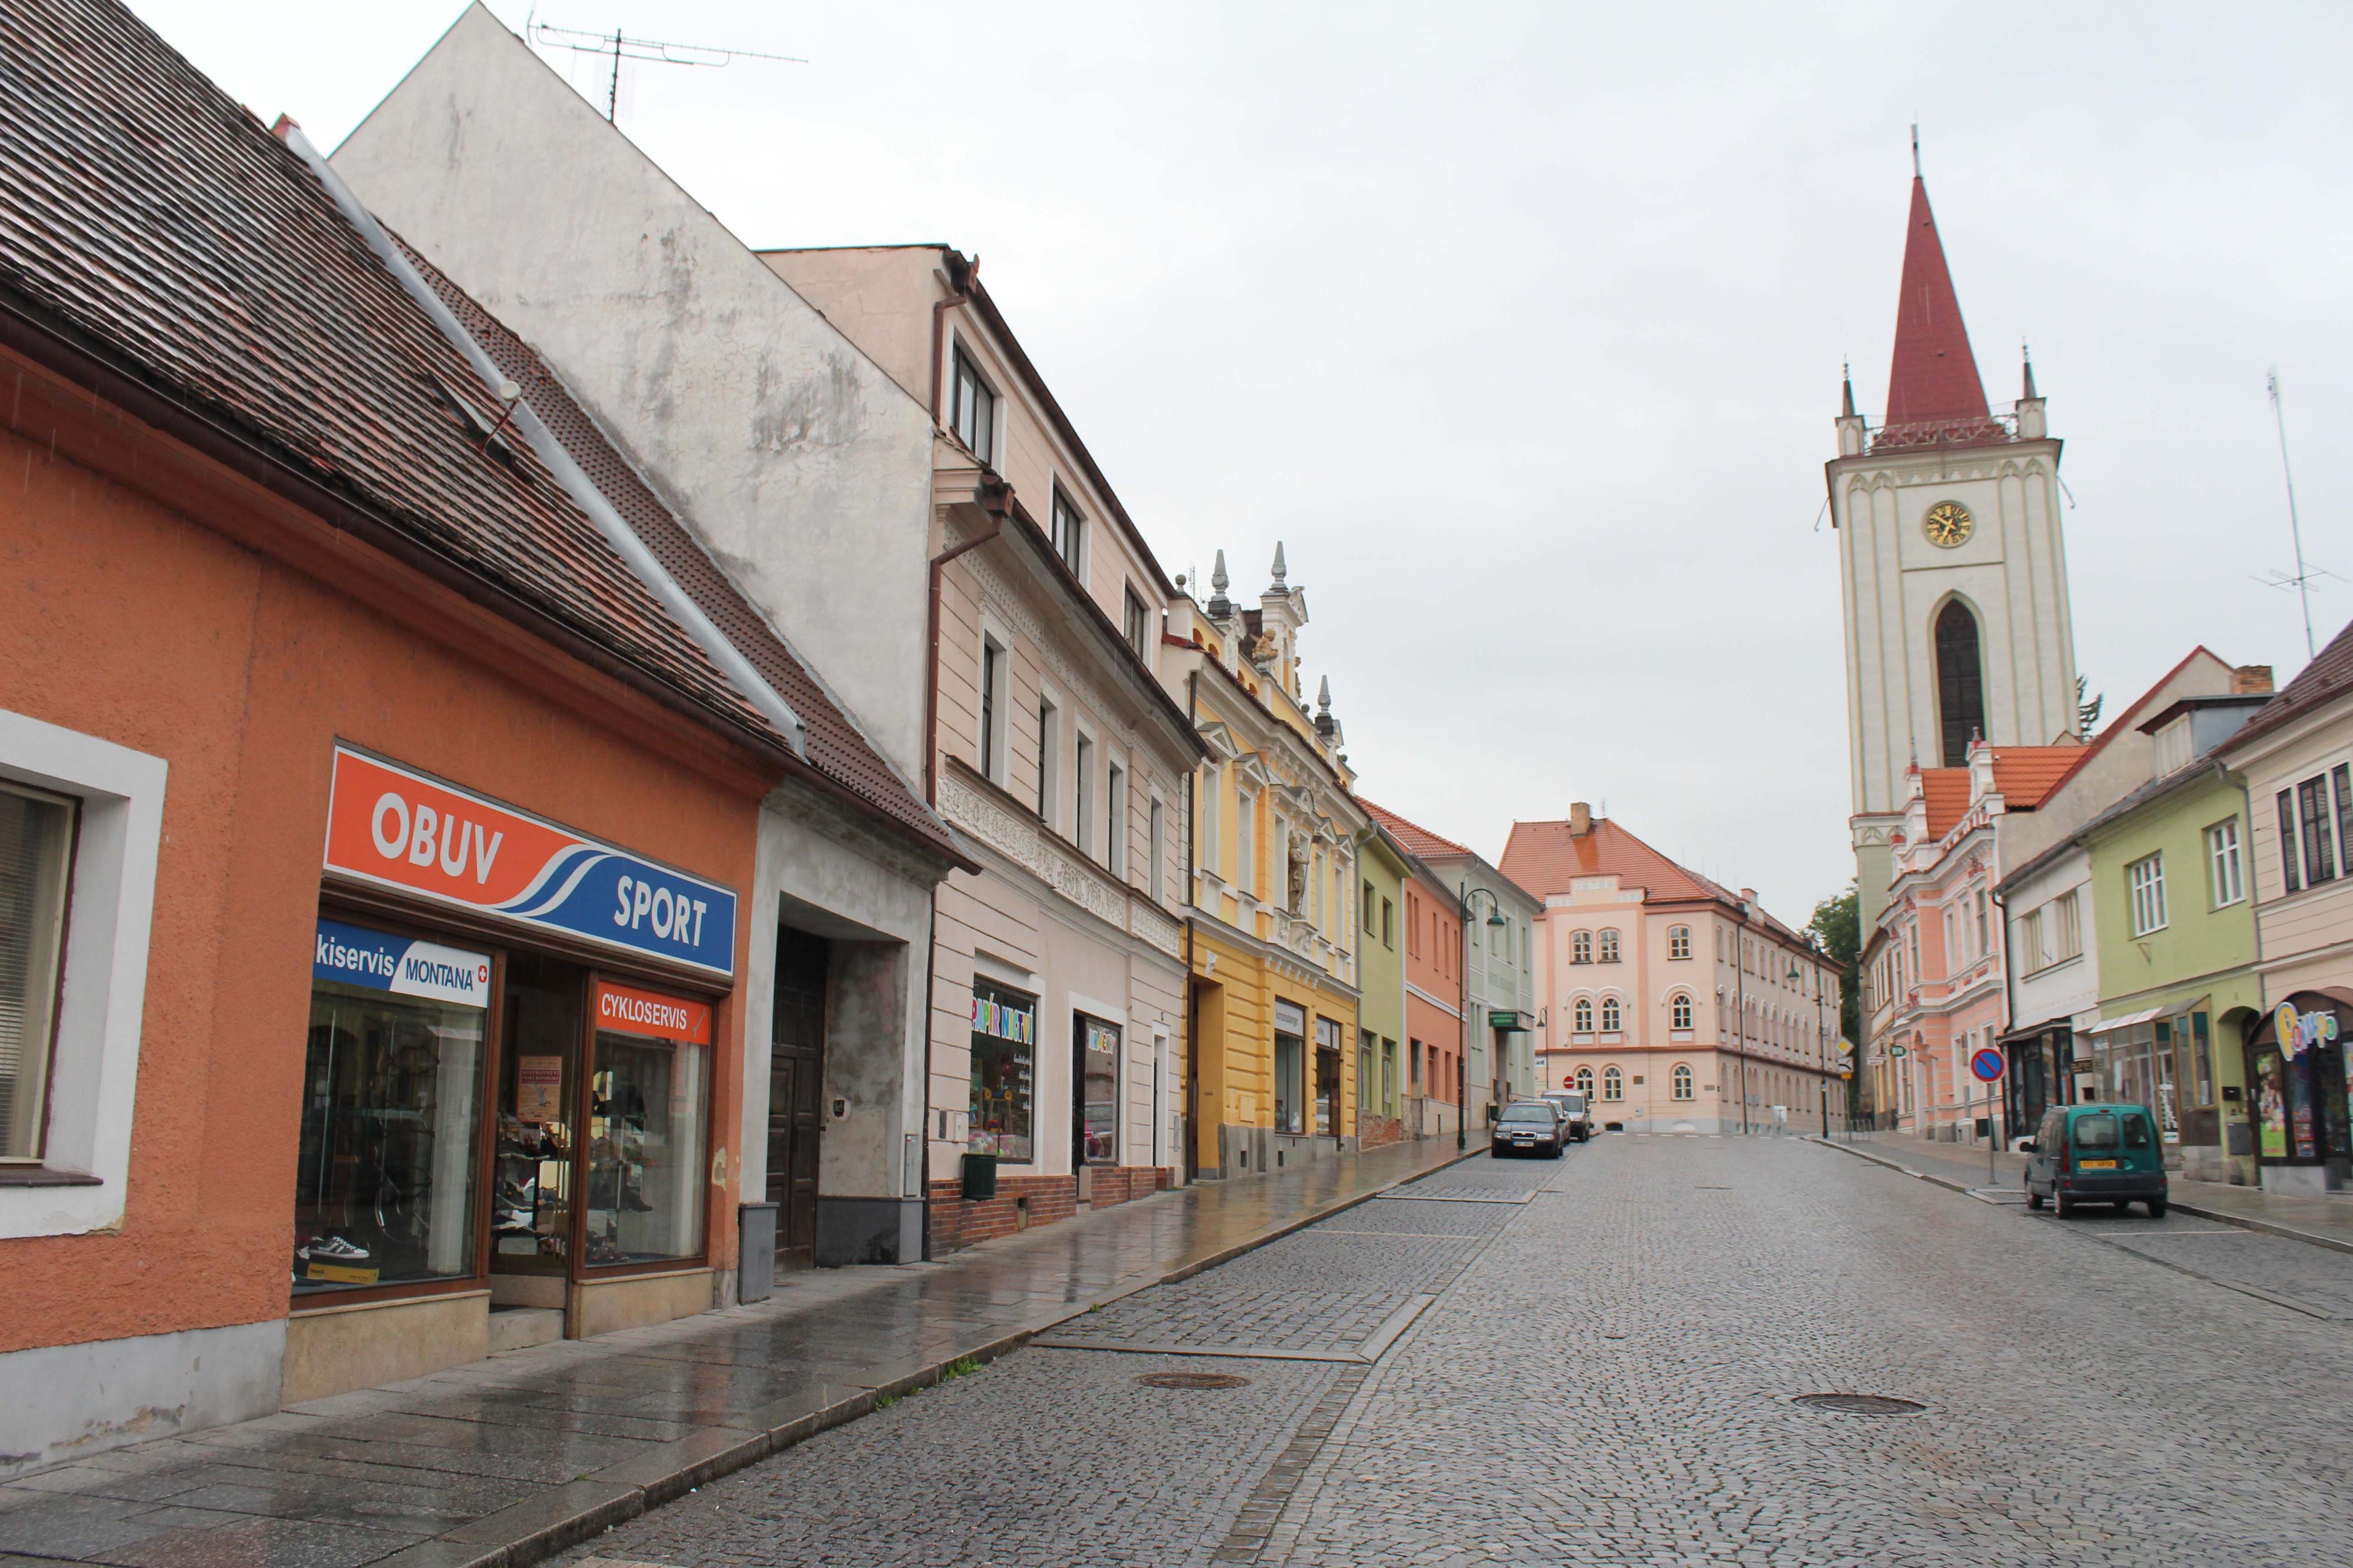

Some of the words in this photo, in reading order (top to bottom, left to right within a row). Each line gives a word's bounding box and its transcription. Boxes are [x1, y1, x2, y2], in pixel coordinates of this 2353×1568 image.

[372, 792, 503, 885] OBUV
[614, 875, 706, 947] SPORT
[405, 958, 474, 991] MONTANA
[601, 993, 687, 1030] CYKLOSERVIS
